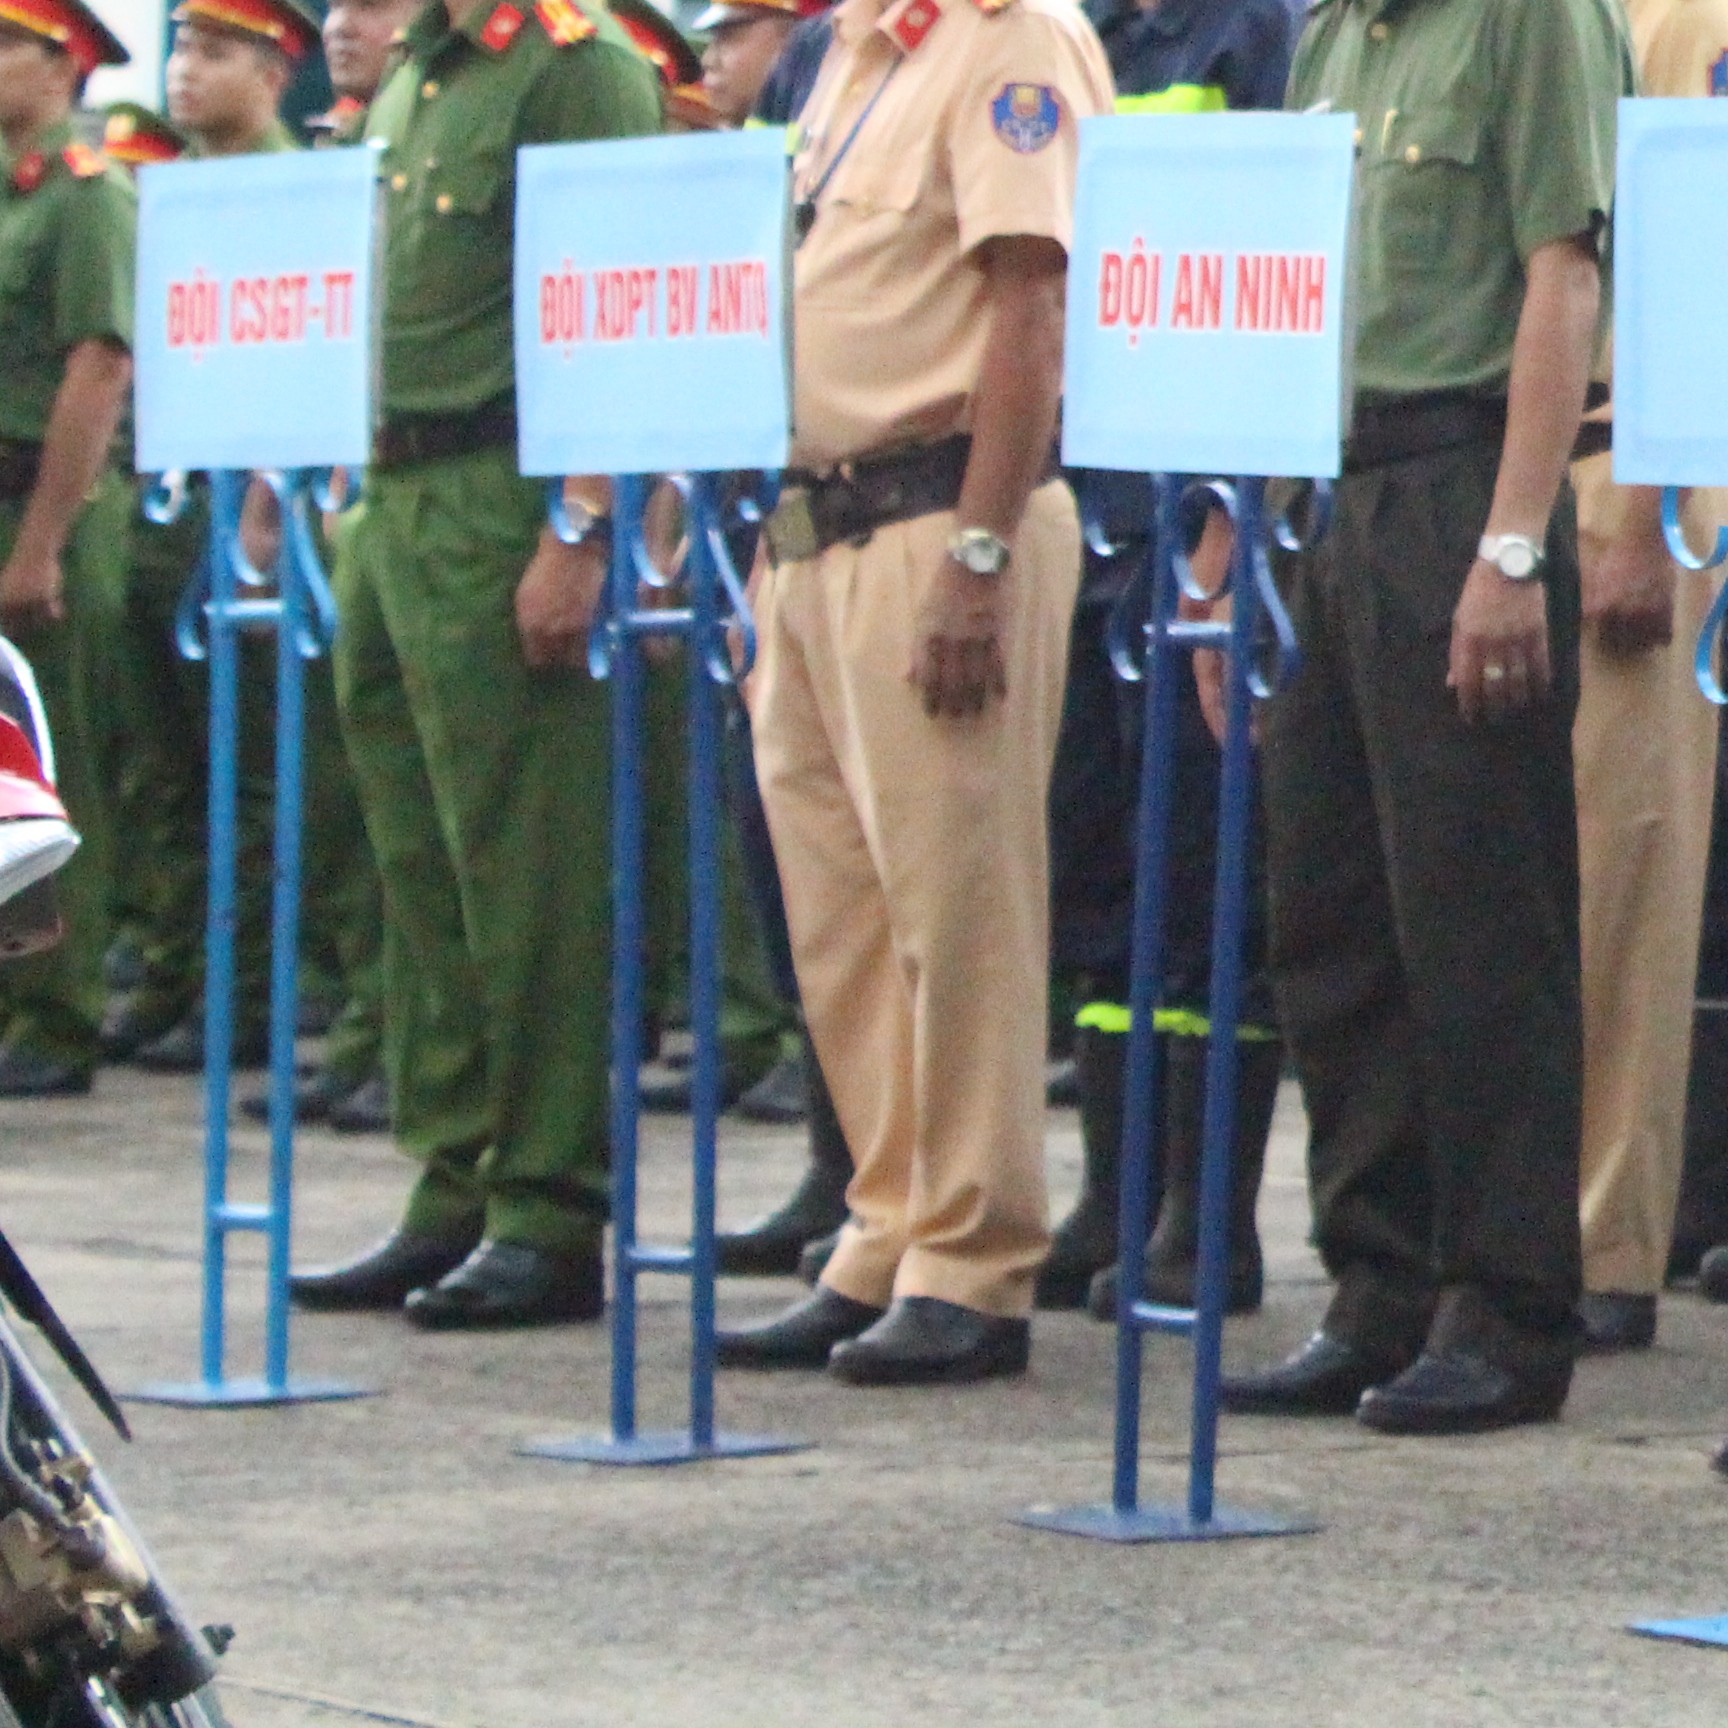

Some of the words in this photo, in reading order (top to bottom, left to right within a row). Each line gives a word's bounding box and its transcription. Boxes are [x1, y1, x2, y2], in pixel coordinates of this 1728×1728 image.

[168, 266, 220, 363] ĐỘI
[1099, 236, 1161, 347] ĐỘI
[1170, 253, 1223, 330] AN
[1233, 254, 1326, 332] NINH
